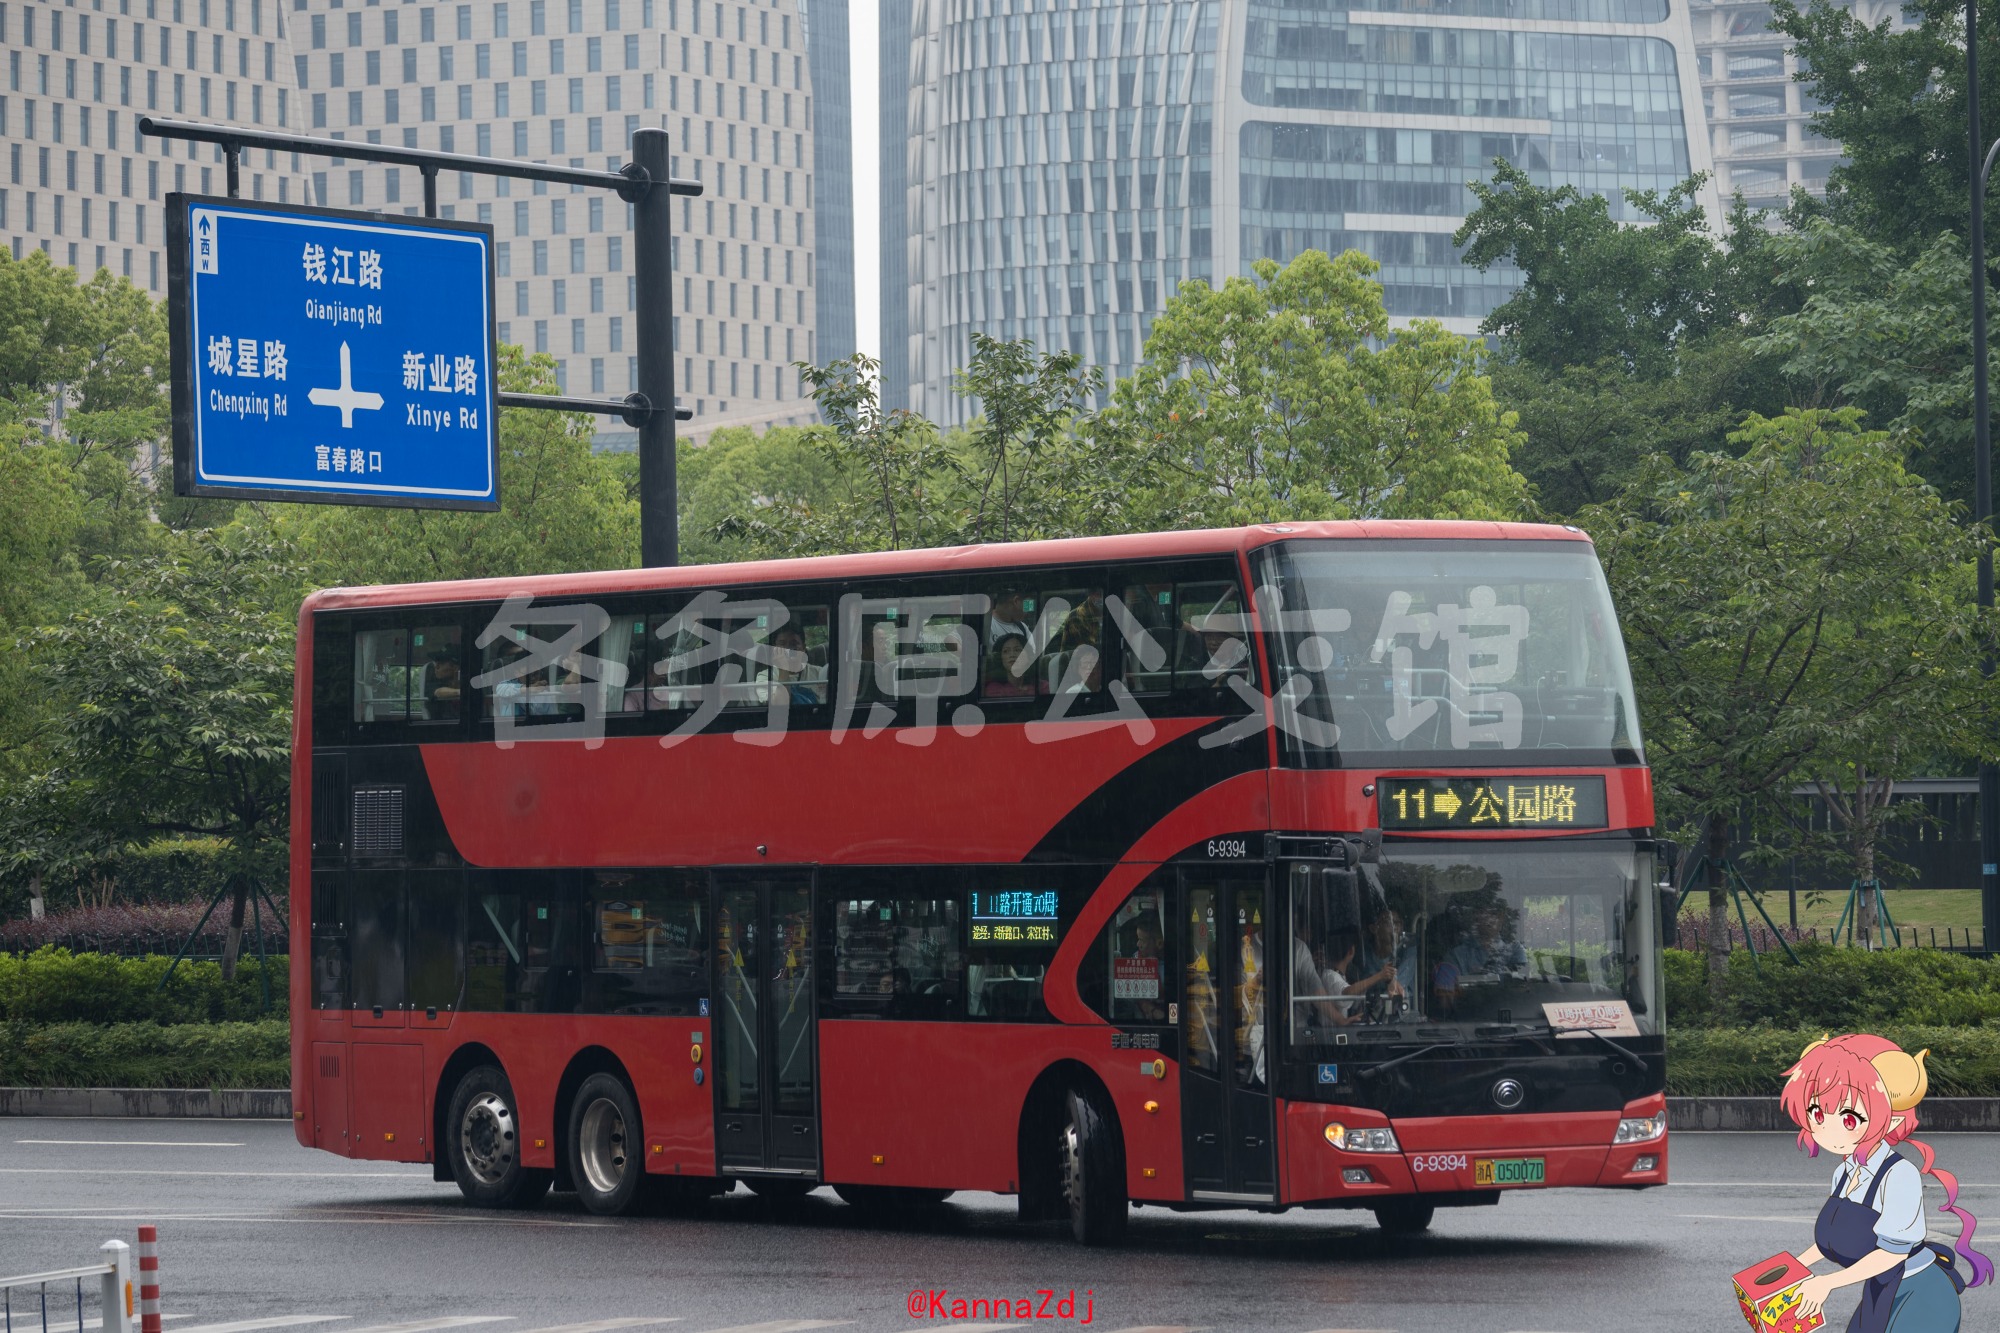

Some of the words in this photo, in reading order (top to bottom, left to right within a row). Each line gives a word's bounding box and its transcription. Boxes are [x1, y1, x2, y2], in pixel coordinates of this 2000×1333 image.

[199, 238, 211, 256] 西
[201, 258, 209, 271] W
[302, 242, 383, 290] 钱江路
[305, 299, 364, 329] Qianjiang
[367, 305, 383, 325] Rd
[207, 335, 288, 381] 城星路
[402, 350, 478, 396] 新业路
[209, 388, 269, 422] Chengxing
[274, 394, 288, 417] Rd
[406, 403, 451, 432] Xinye
[459, 407, 478, 430] Rd
[315, 445, 382, 474] 富春路口
[1392, 788, 1426, 820] 11
[1469, 784, 1577, 823] 公园路
[1208, 840, 1246, 857] 6-9394
[989, 891, 1058, 916] 11路开通70周
[1413, 1154, 1467, 1173] 6-9394
